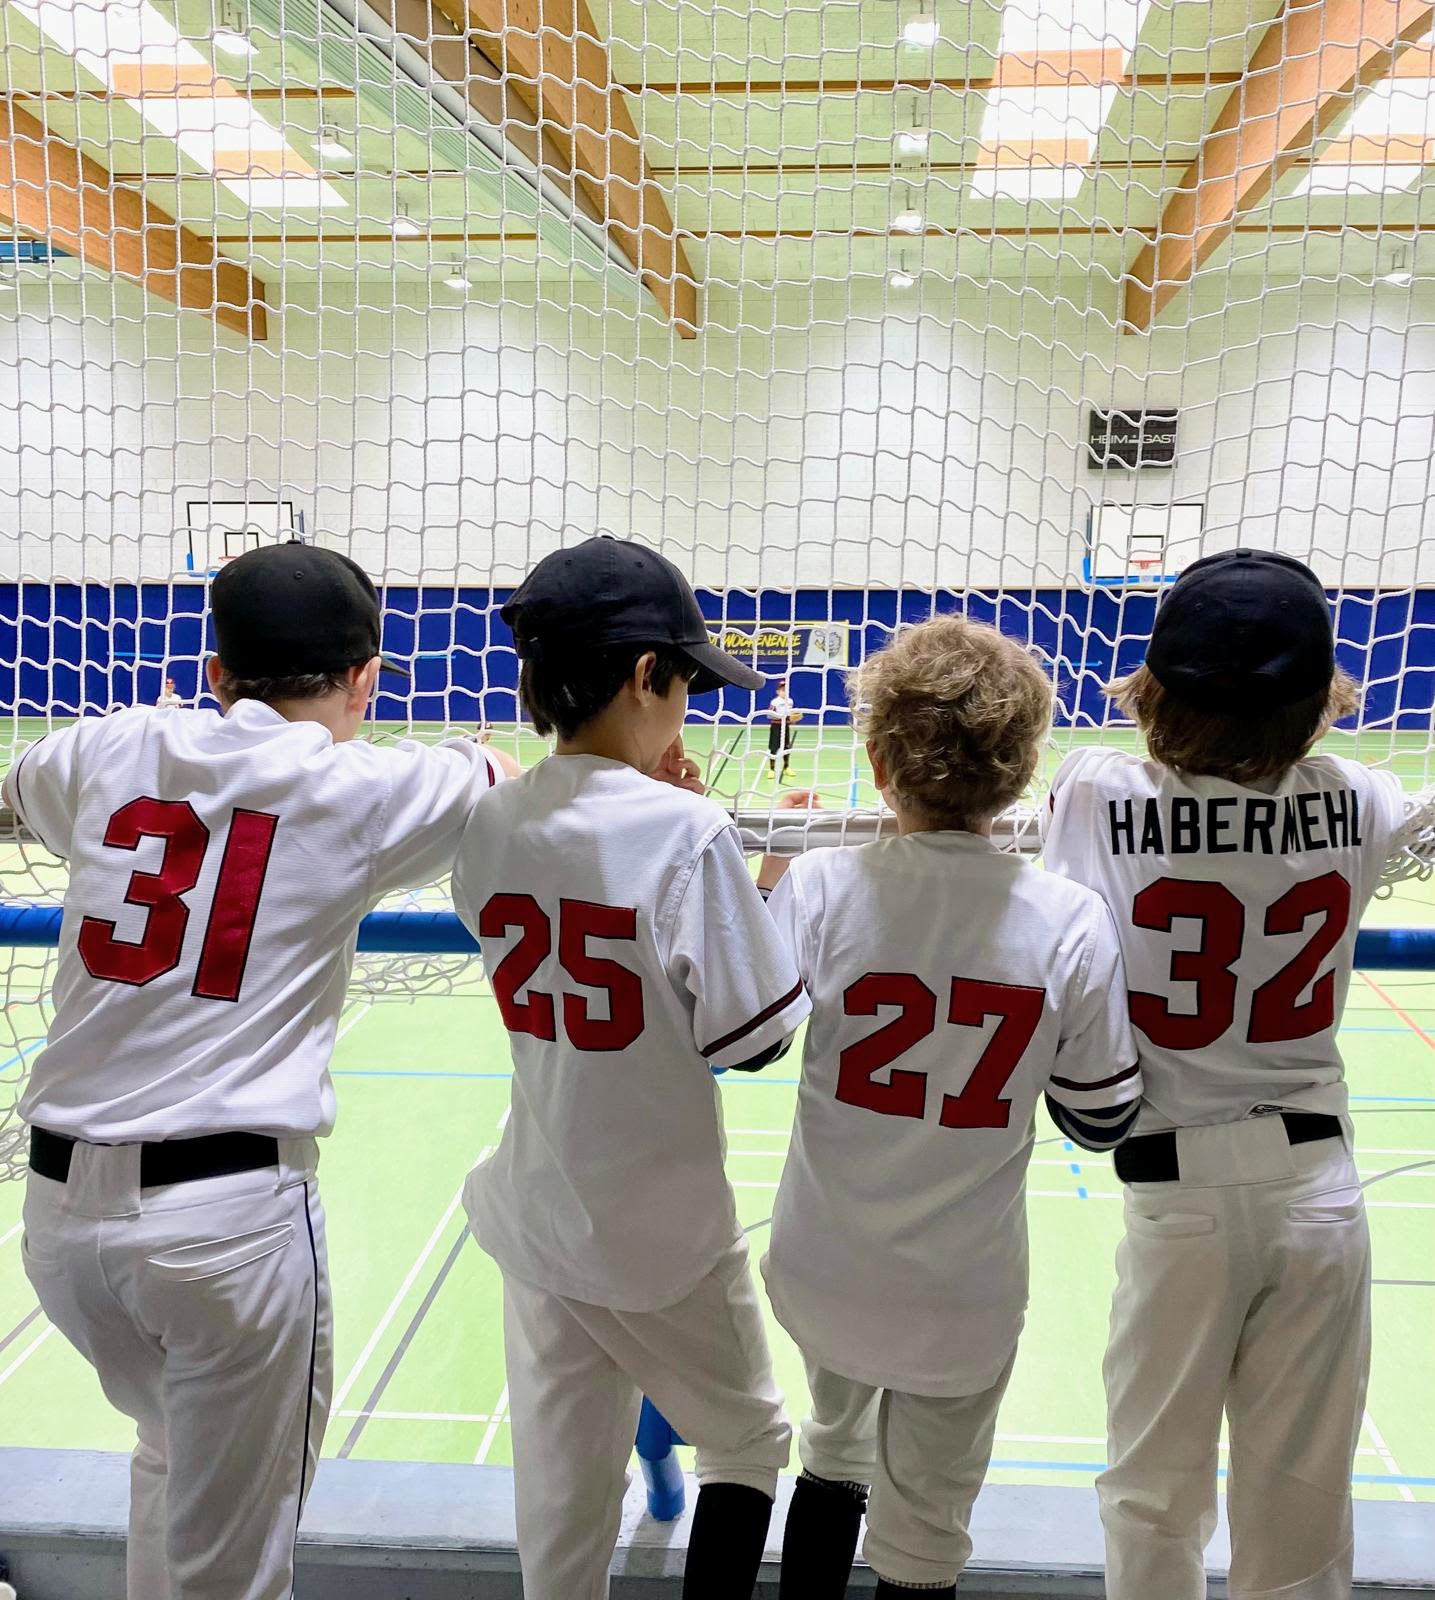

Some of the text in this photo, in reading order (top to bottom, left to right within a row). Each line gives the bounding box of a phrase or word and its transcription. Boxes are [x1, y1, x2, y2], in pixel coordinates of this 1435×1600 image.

[1090, 434, 1177, 444] HEIM GAST
[723, 634, 801, 647] WOCHENENE
[77, 796, 279, 1002] 31
[1109, 790, 1362, 855] HABERMEHL
[480, 893, 645, 1051] 25
[1127, 870, 1352, 1051] 32
[835, 972, 1046, 1128] 27
